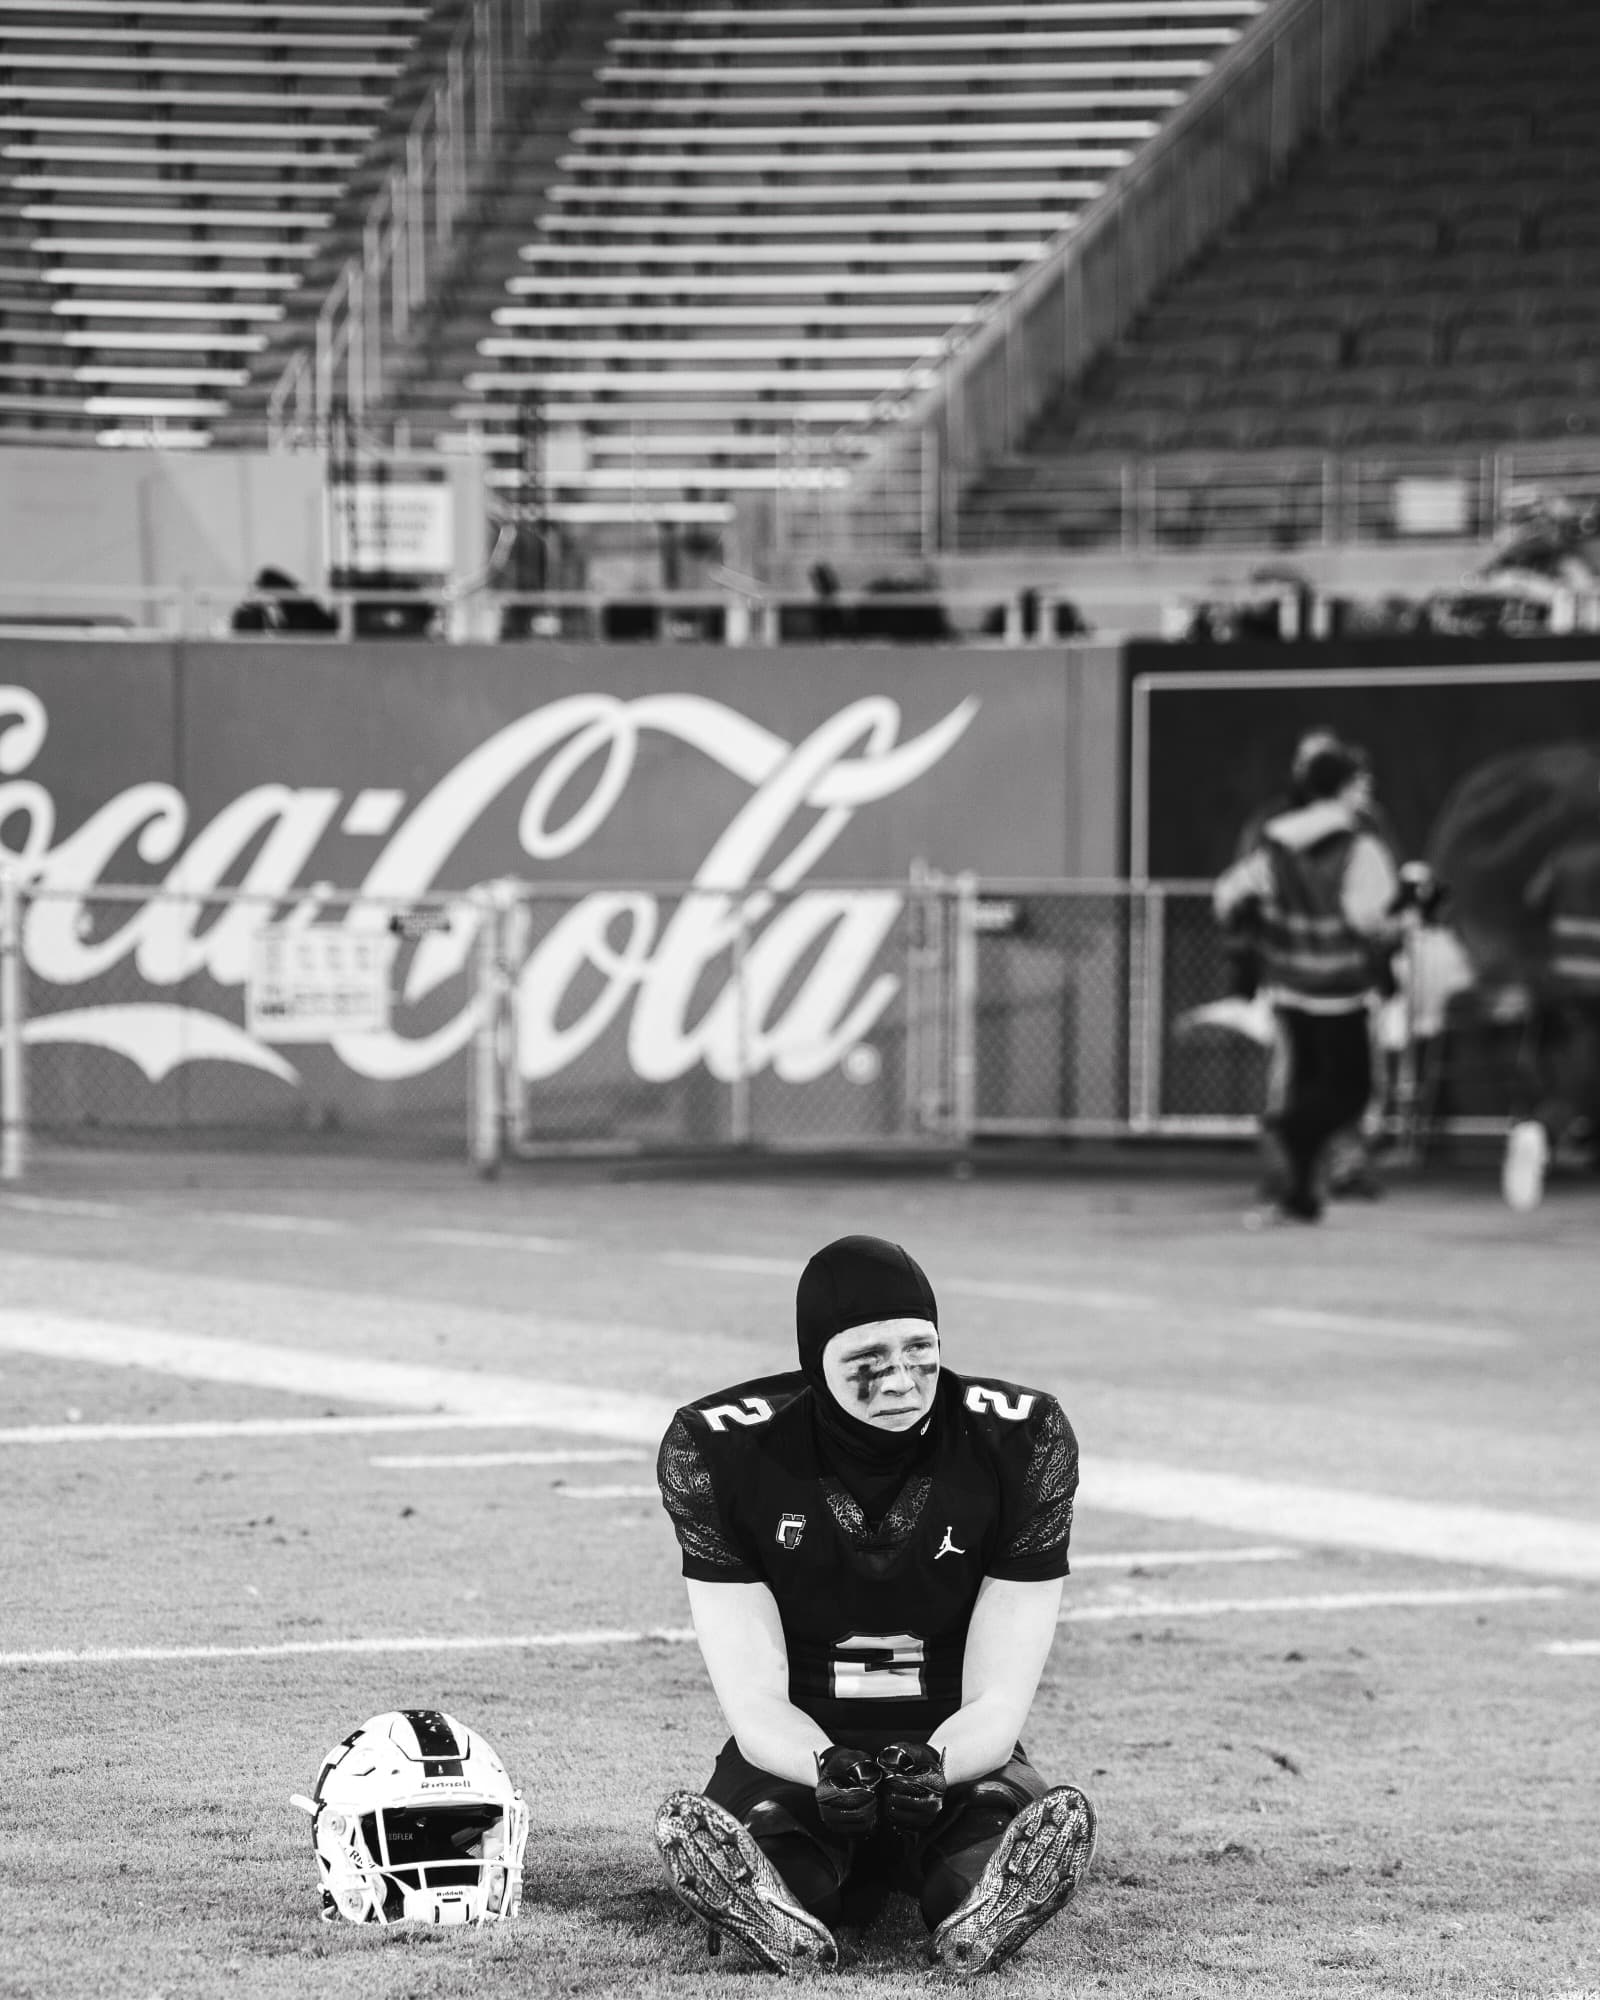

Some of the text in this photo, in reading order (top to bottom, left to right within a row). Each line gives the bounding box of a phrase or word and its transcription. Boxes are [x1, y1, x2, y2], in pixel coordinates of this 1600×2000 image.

[0, 684, 980, 1084] ca-Cola
[701, 1397, 774, 1431] 2
[966, 1385, 1034, 1420] 2
[832, 1633, 925, 1699] 2
